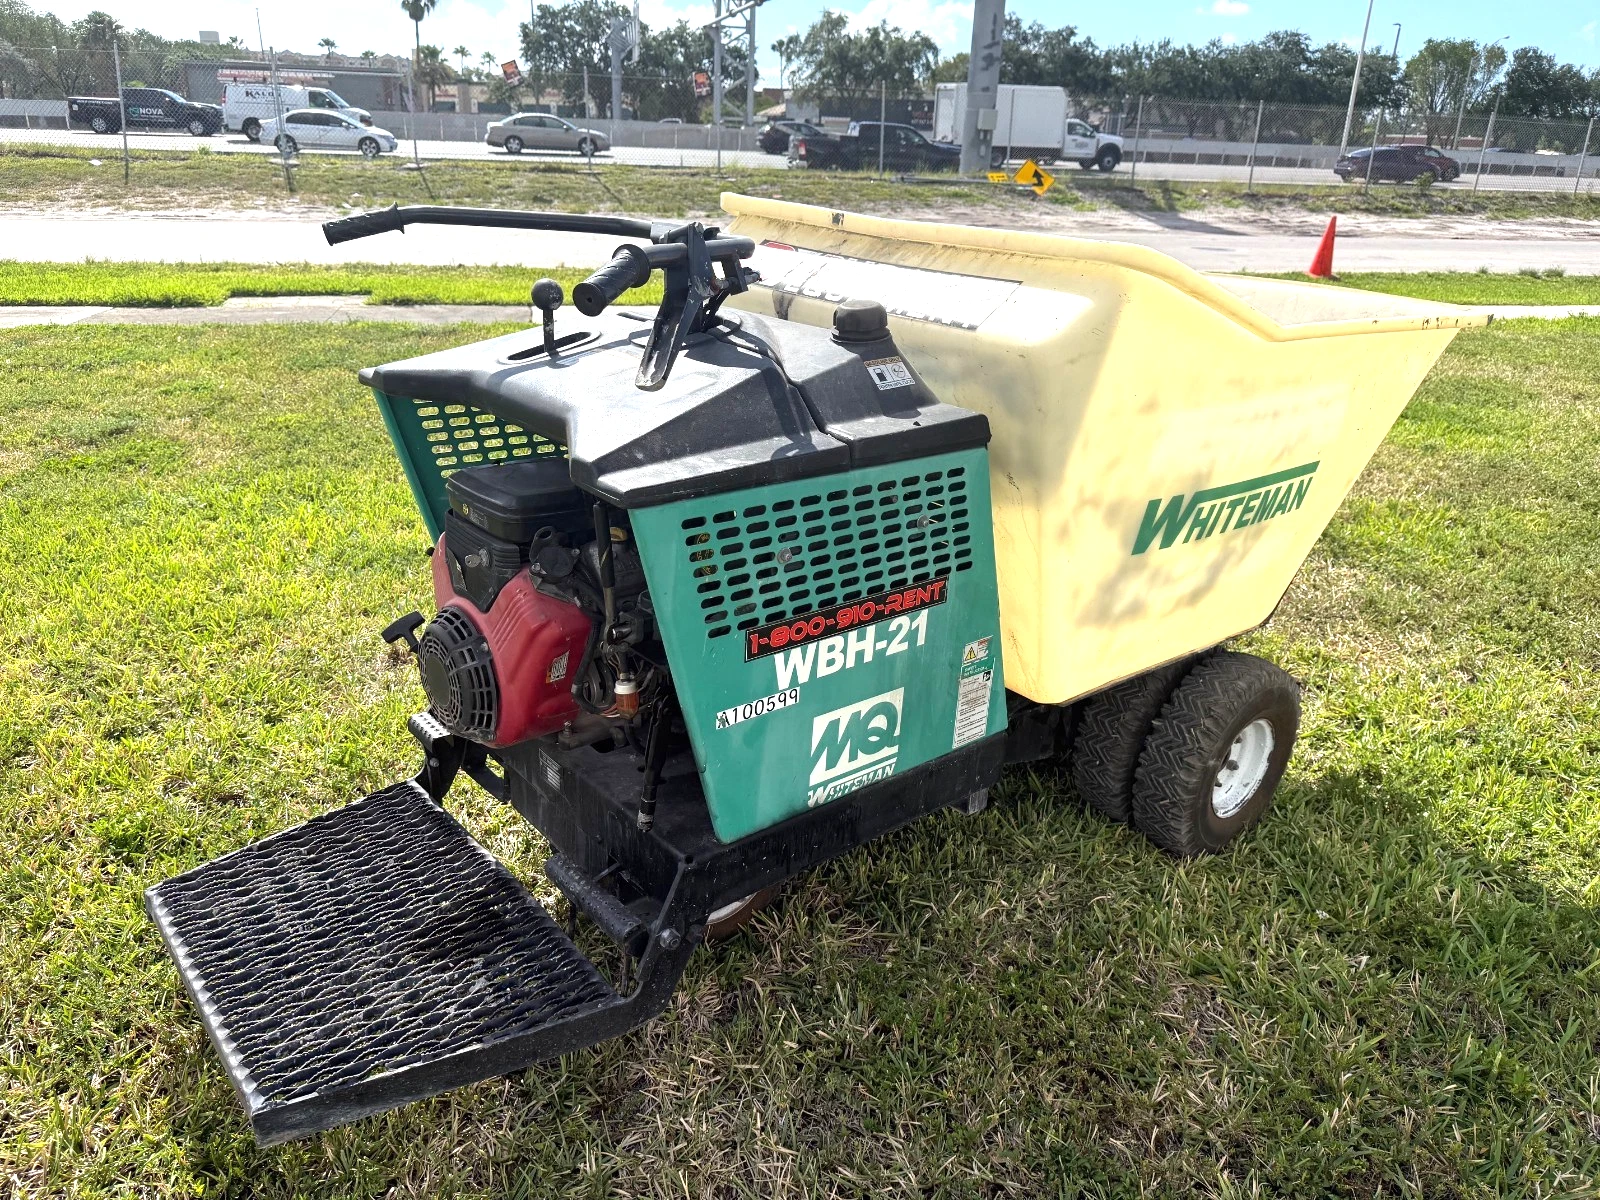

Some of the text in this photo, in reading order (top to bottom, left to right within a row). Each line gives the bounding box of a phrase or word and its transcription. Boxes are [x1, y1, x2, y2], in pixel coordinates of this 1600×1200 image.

[140, 107, 164, 115] NOVA
[1131, 460, 1321, 556] WHITEMAN
[749, 581, 946, 654] 1-800-910-RENT
[773, 608, 929, 691] WBH-21
[717, 688, 798, 729] A100599
[808, 700, 900, 772] MQ
[807, 756, 898, 808] WHITEMAN
